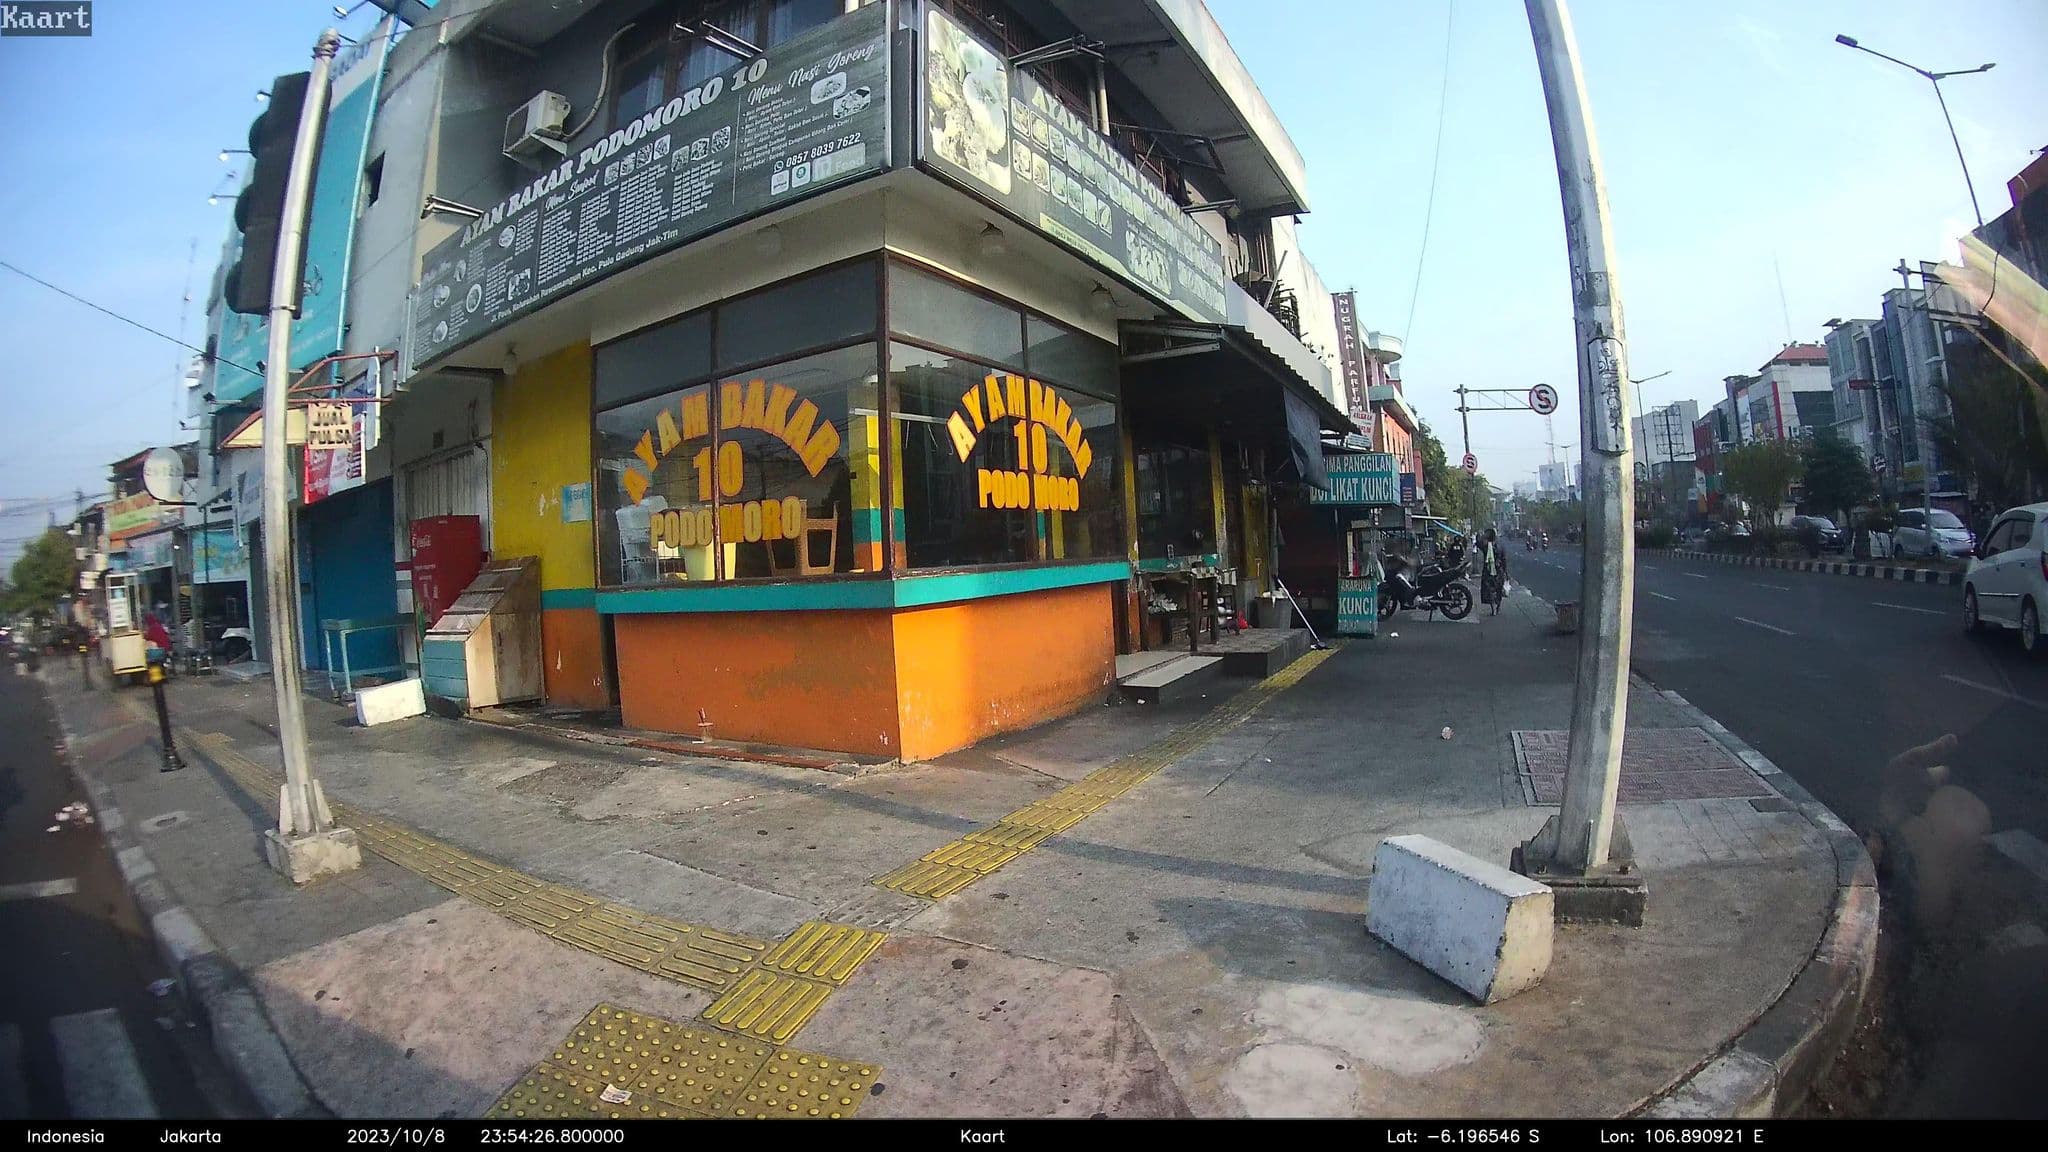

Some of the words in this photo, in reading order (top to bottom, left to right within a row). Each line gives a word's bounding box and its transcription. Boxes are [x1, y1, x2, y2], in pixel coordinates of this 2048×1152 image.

[748, 82, 783, 106] Menu
[789, 65, 821, 88] Nasi
[827, 44, 877, 74] Goreng
[460, 202, 506, 248] AYAM
[507, 160, 574, 217] BAKAR
[576, 77, 724, 174] PODOMORO
[731, 58, 769, 92] 10
[786, 151, 809, 168] 0857
[811, 141, 834, 159] 8039
[837, 132, 861, 150] 7622
[1031, 86, 1085, 143] AYAM
[1087, 128, 1139, 190] BAKAR
[1202, 233, 1214, 254] 10
[946, 373, 1027, 464] AYAM
[1537, 389, 1551, 409] S
[309, 428, 353, 446] PULSA
[623, 391, 709, 506] AYAM
[1013, 419, 1048, 474] 10
[1343, 455, 1391, 473] PANGGILAN
[693, 440, 744, 502] 10
[1361, 477, 1393, 502] KUNCI
[1339, 597, 1373, 615] KUNCI
